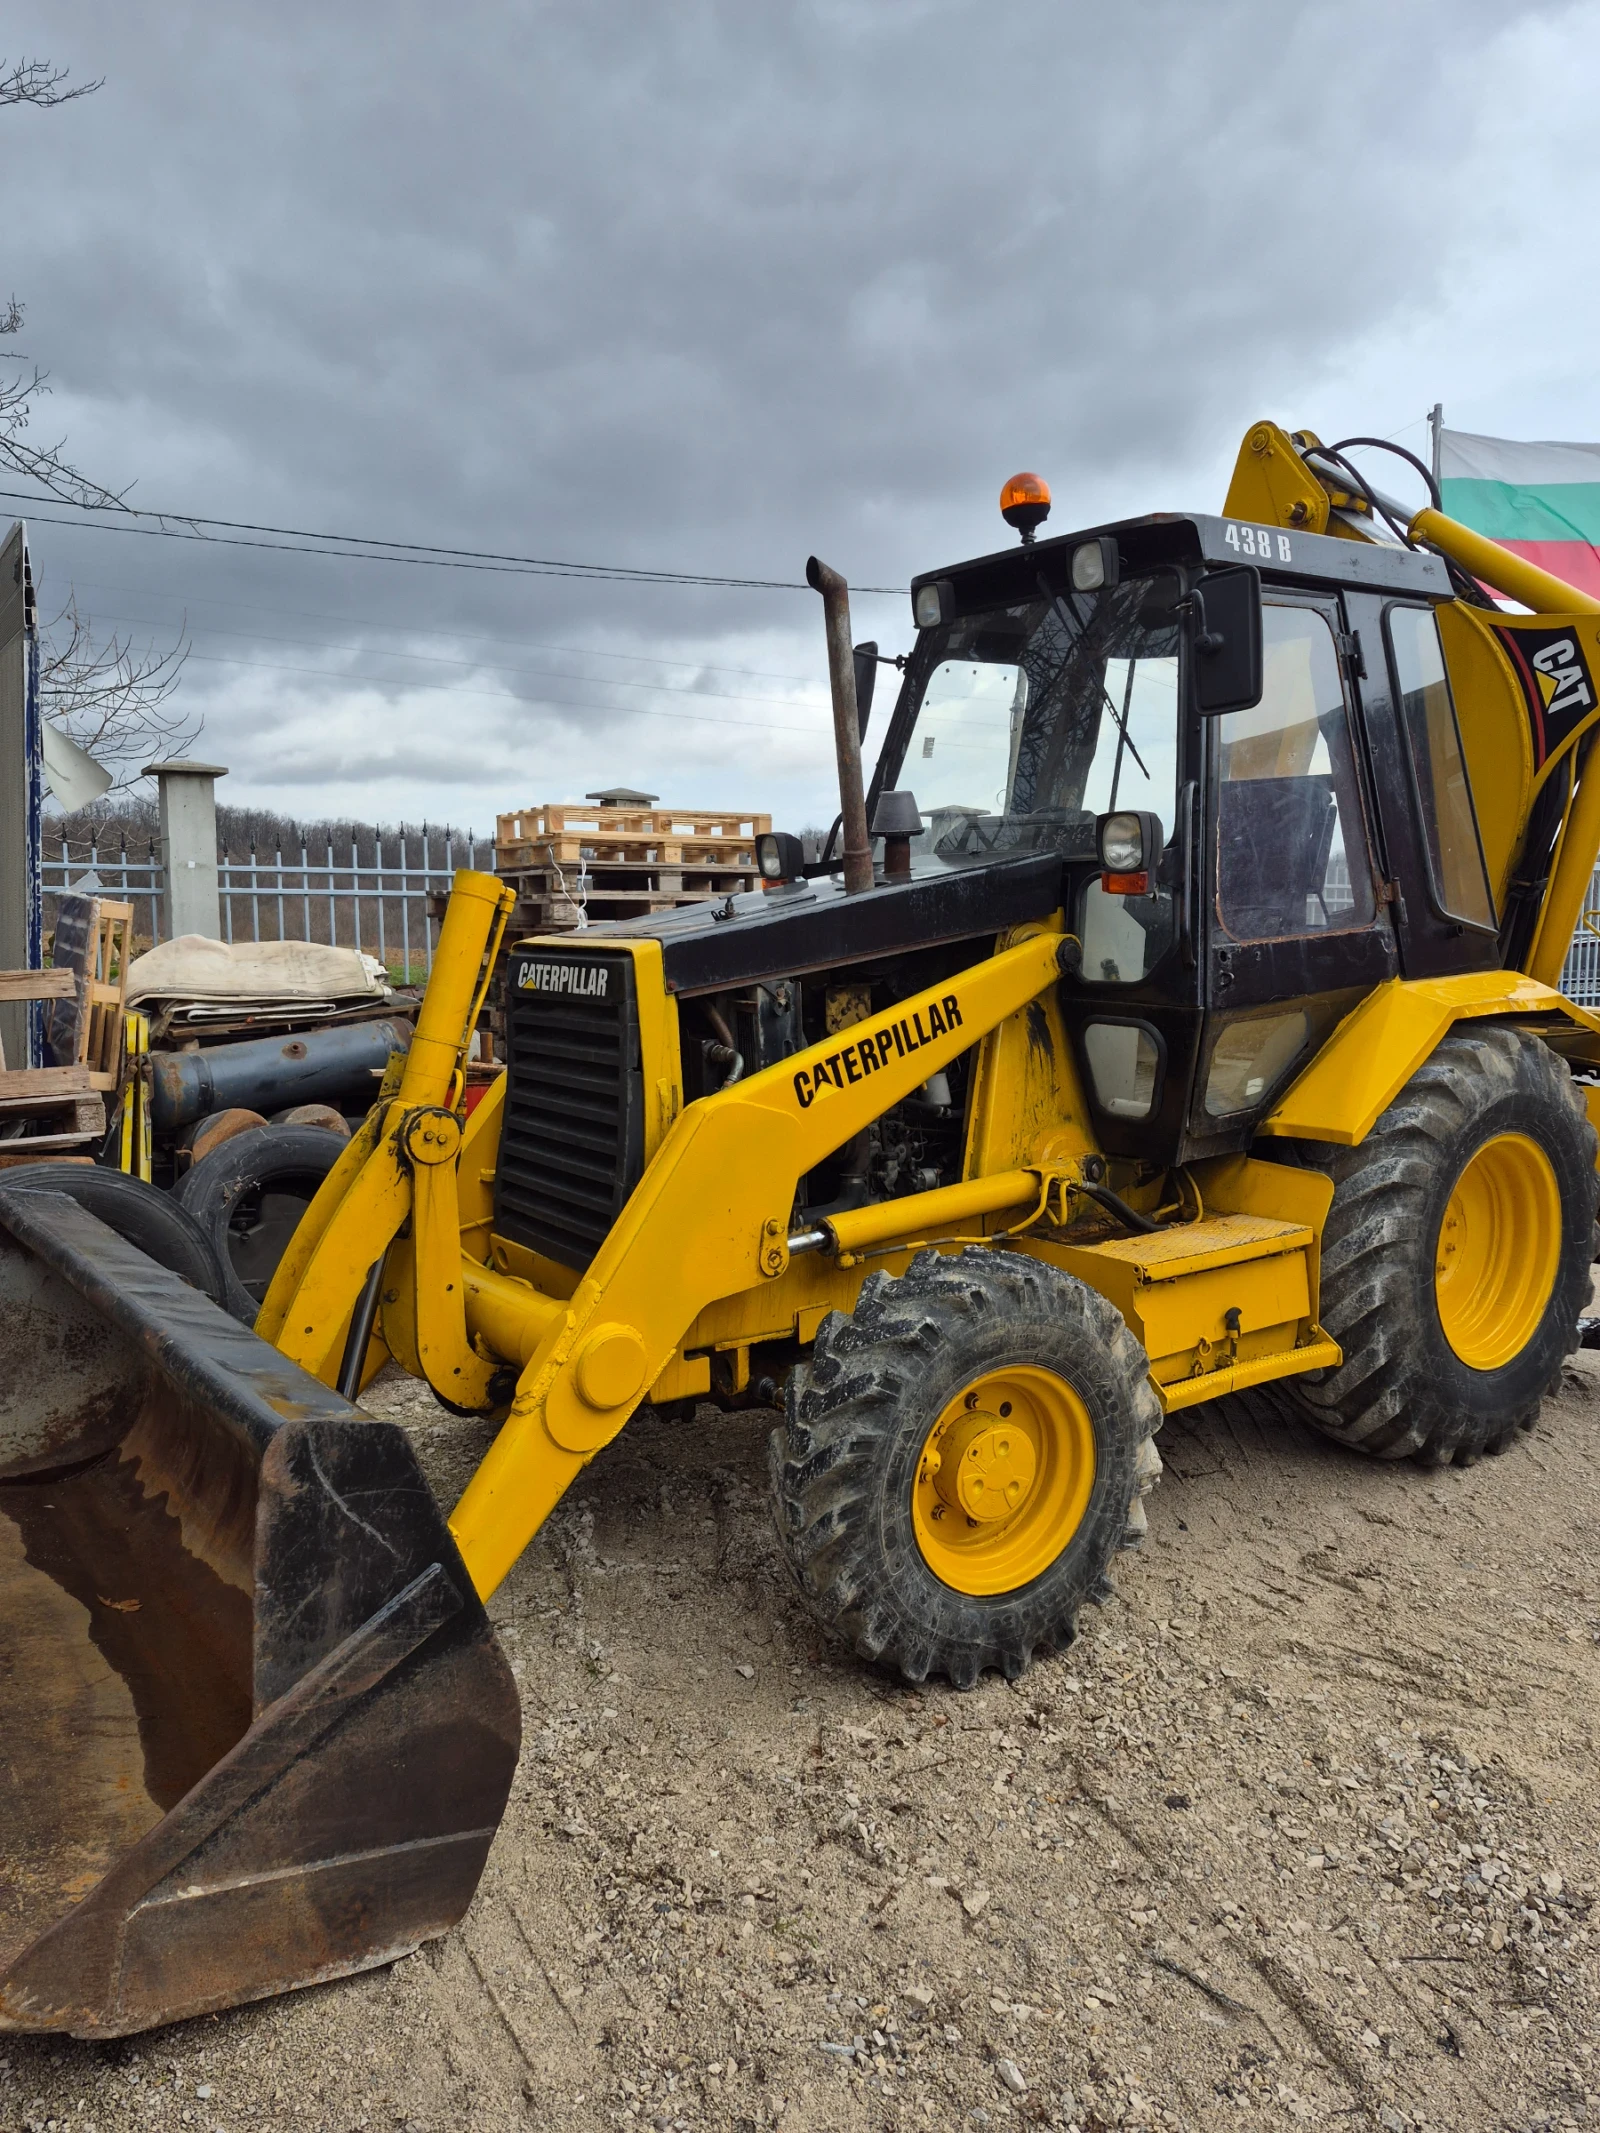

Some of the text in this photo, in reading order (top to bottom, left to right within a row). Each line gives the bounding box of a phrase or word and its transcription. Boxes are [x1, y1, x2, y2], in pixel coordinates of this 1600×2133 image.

[1225, 524, 1292, 562] 438 B
[1533, 639, 1591, 714] CAT
[518, 962, 608, 996] CATERPILLAR
[793, 994, 963, 1108] CATERPILLAR
